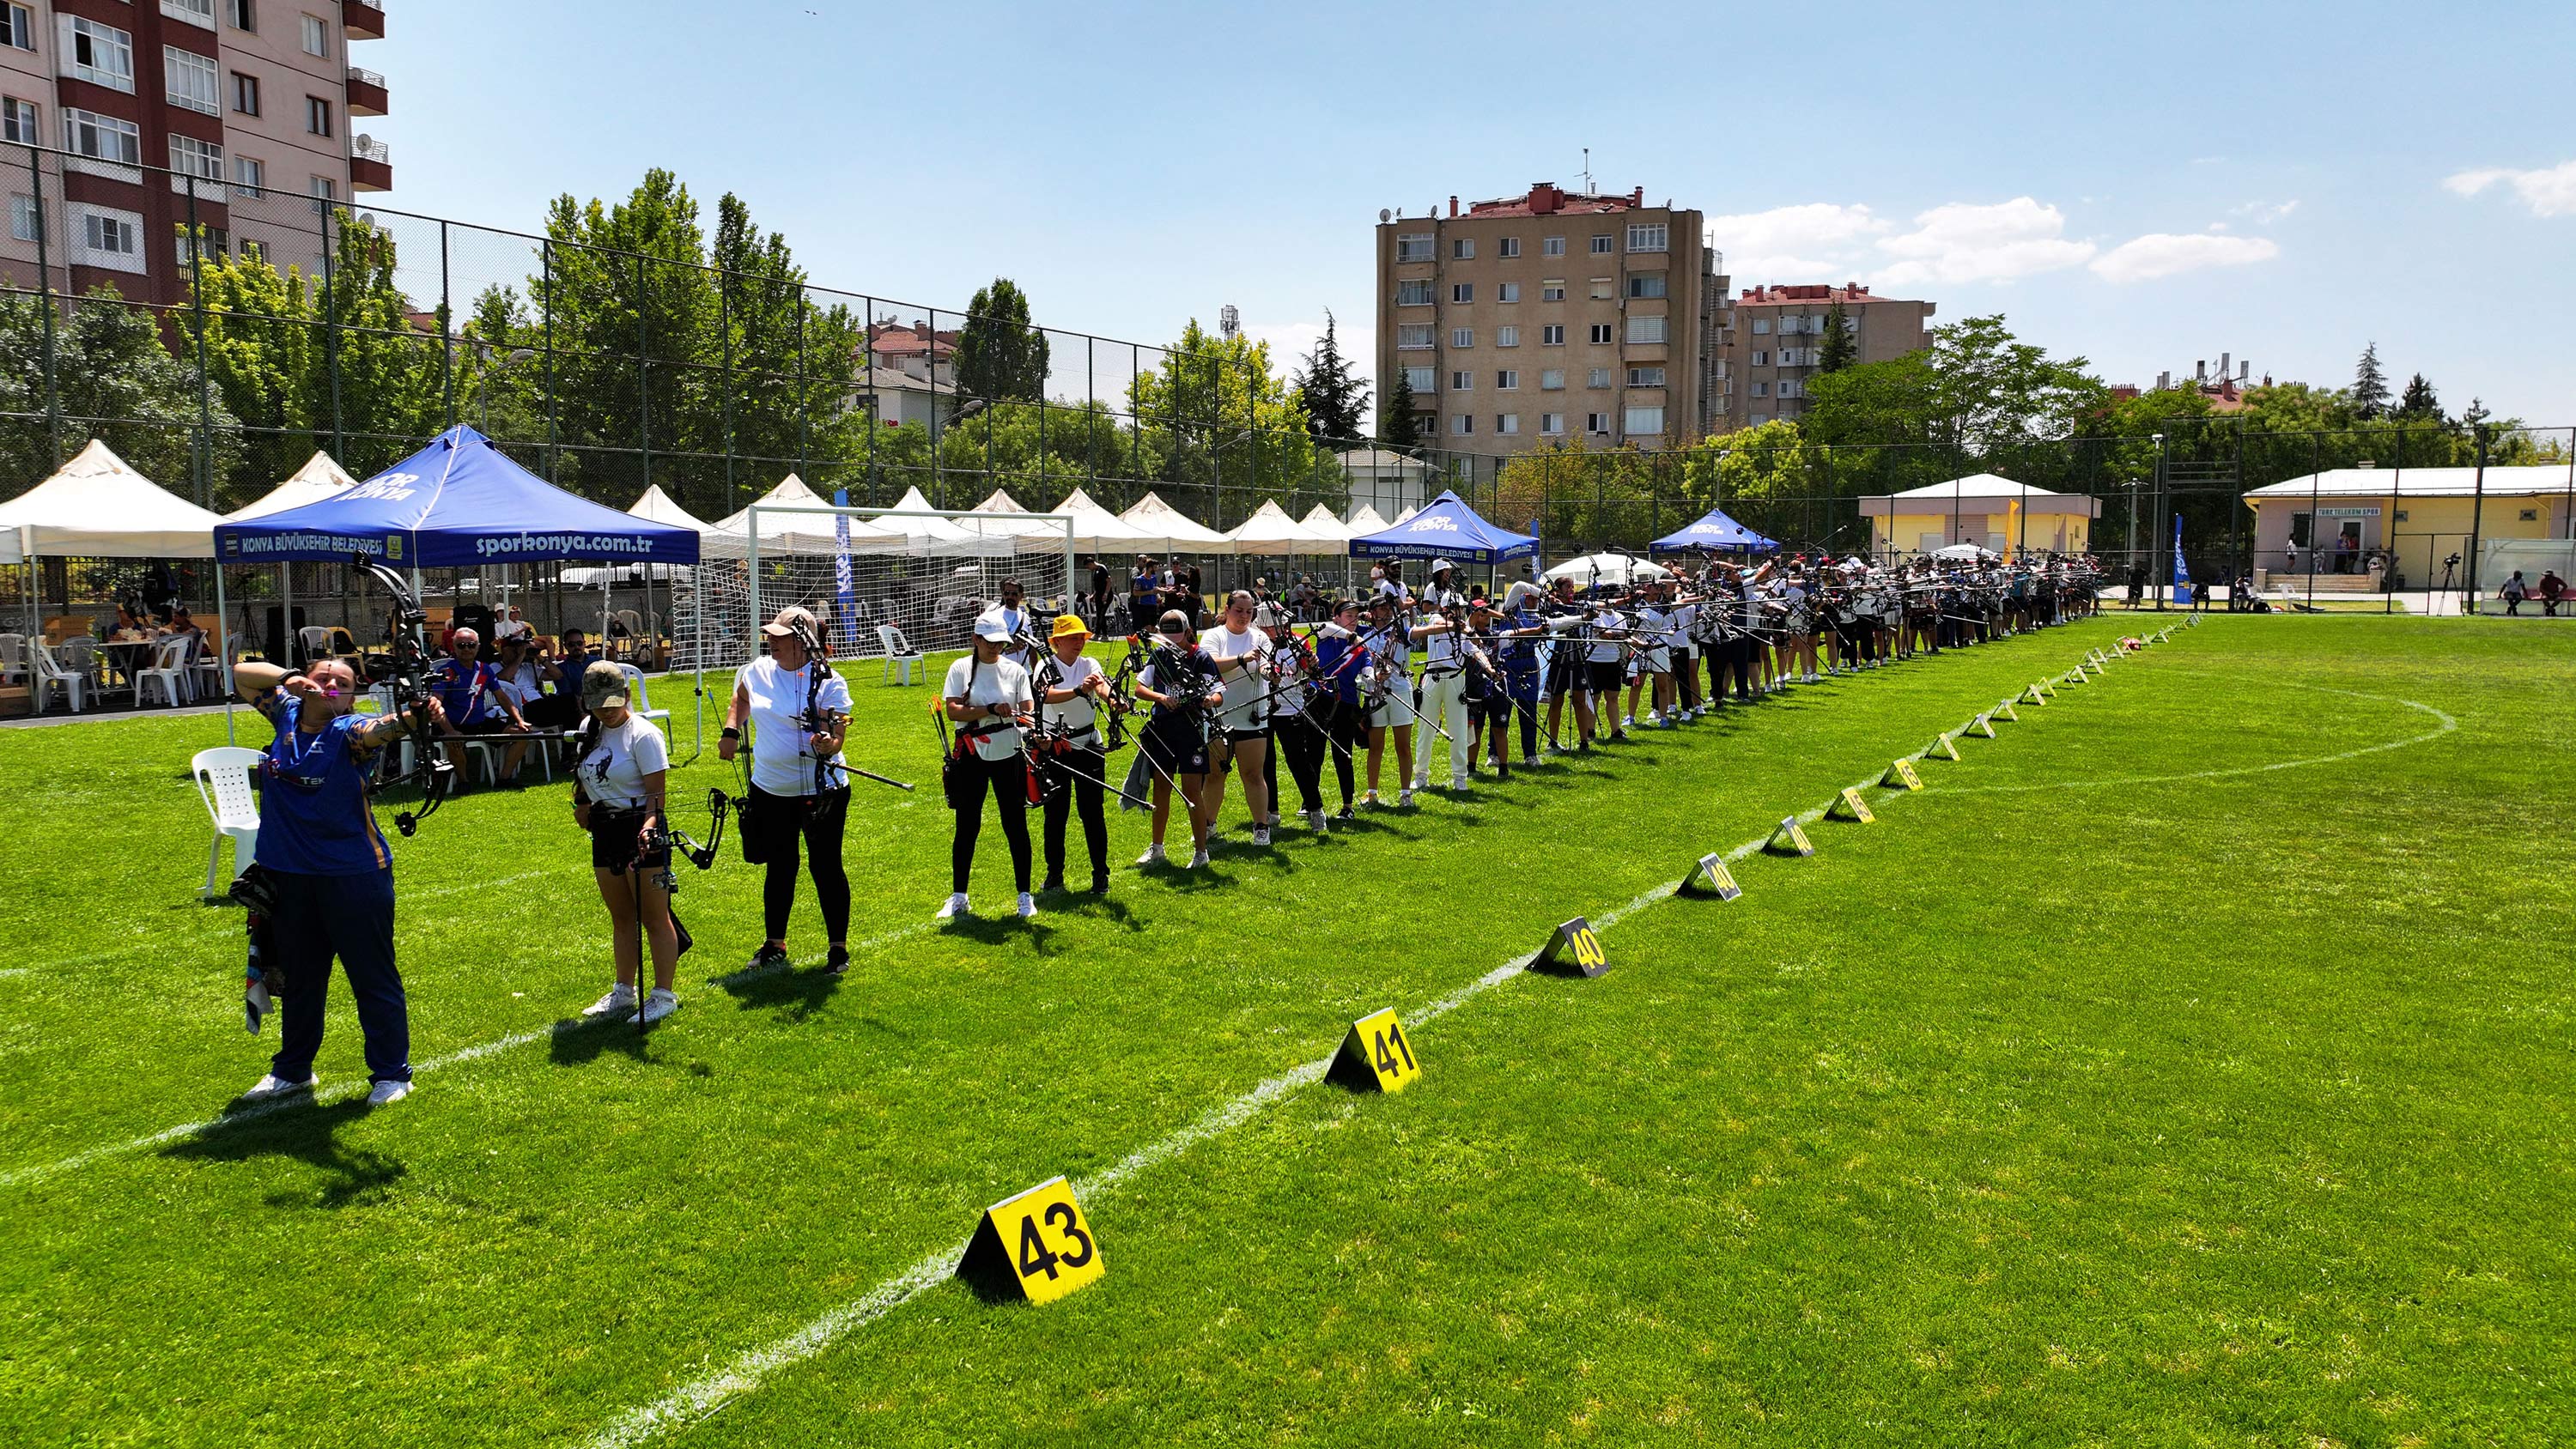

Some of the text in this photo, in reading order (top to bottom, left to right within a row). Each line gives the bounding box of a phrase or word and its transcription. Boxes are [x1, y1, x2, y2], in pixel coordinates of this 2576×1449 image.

[242, 537, 274, 552] KONYA
[476, 530, 653, 557] sporkonya.com.tr
[1901, 765, 1919, 787] 15
[1850, 794, 1870, 818] 45
[1790, 824, 1812, 852] 40
[1710, 862, 1735, 891] 40
[1572, 928, 1605, 969] 40
[1375, 1022, 1414, 1078] 41
[1019, 1202, 1093, 1282] 43
